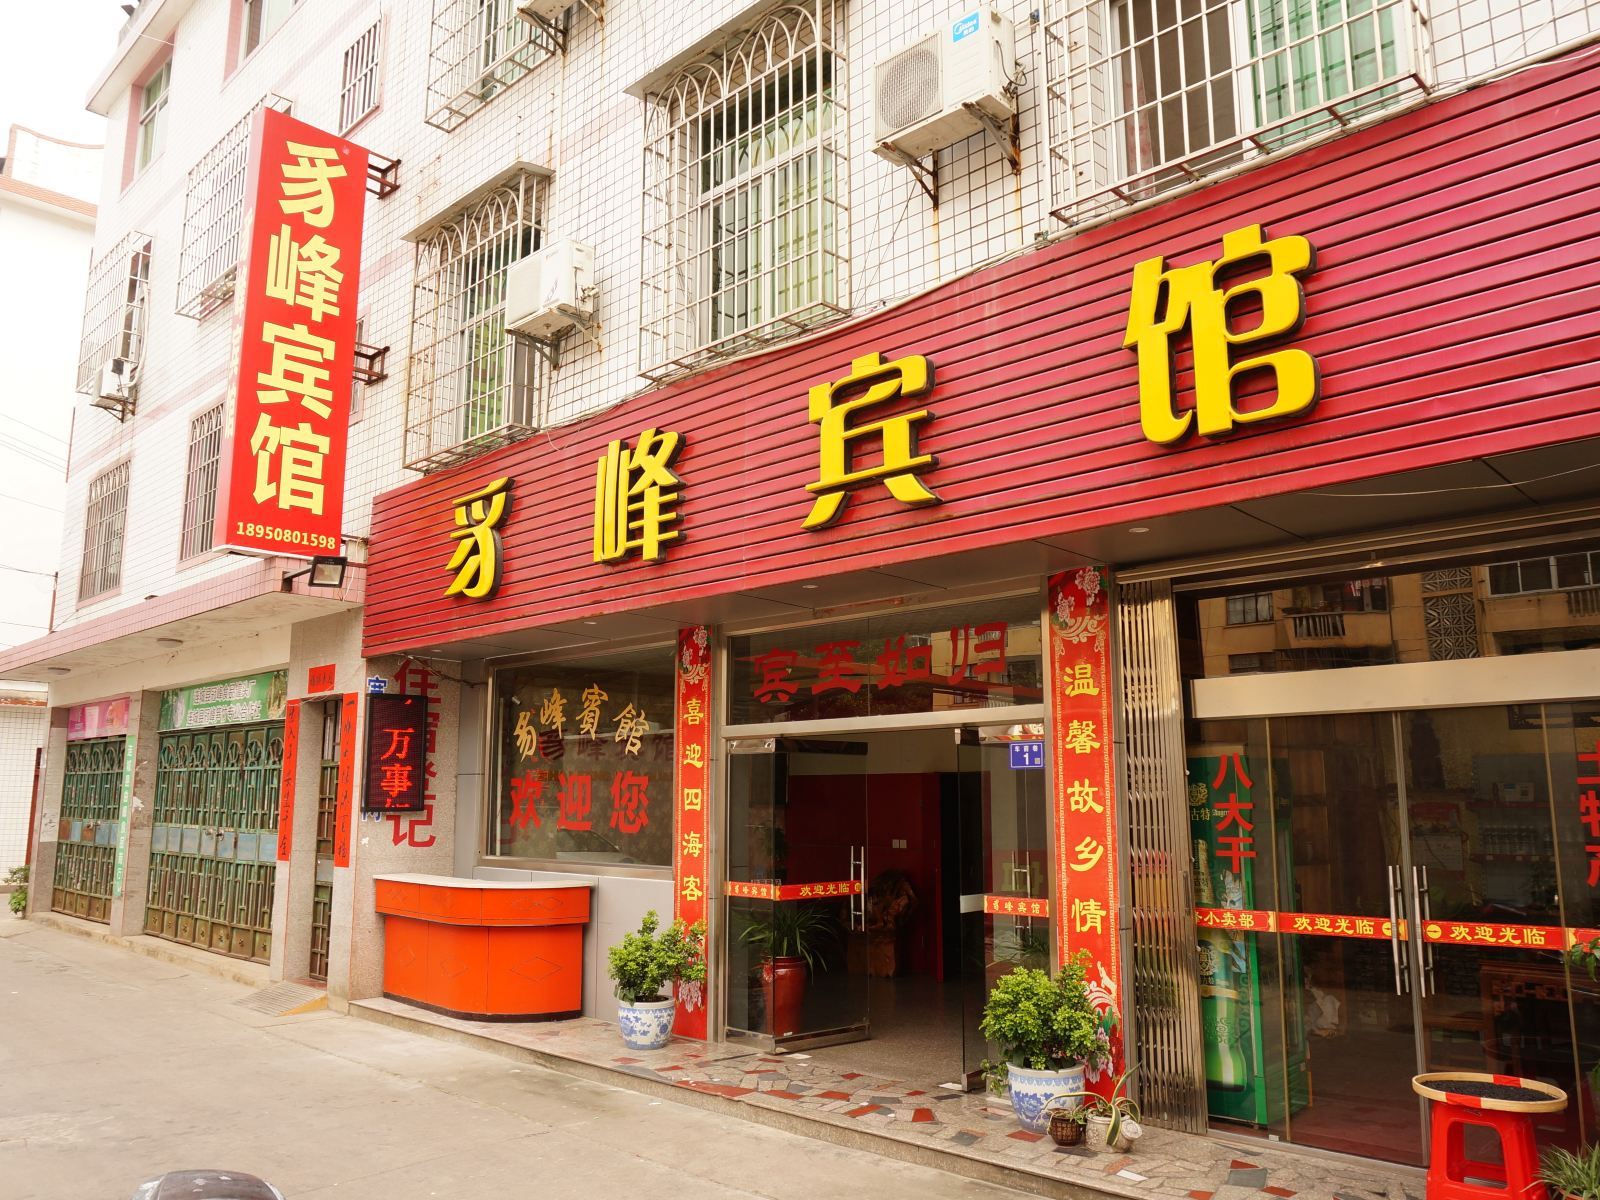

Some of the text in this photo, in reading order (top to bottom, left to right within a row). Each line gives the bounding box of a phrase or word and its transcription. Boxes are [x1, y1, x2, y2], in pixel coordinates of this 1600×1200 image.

[236, 522, 336, 550] 18950801598
[754, 622, 1009, 704] 宾至如归
[1023, 753, 1029, 765] 1
[509, 770, 650, 834] 欢迎您
[682, 698, 704, 902] 喜迎四海客
[1062, 663, 1107, 935] 温馨故乡情
[1212, 752, 1257, 873] 八大干
[800, 883, 850, 896] 欢迎光临
[1293, 917, 1375, 935] 欢迎光临
[1450, 926, 1547, 945] 欢迎光临
